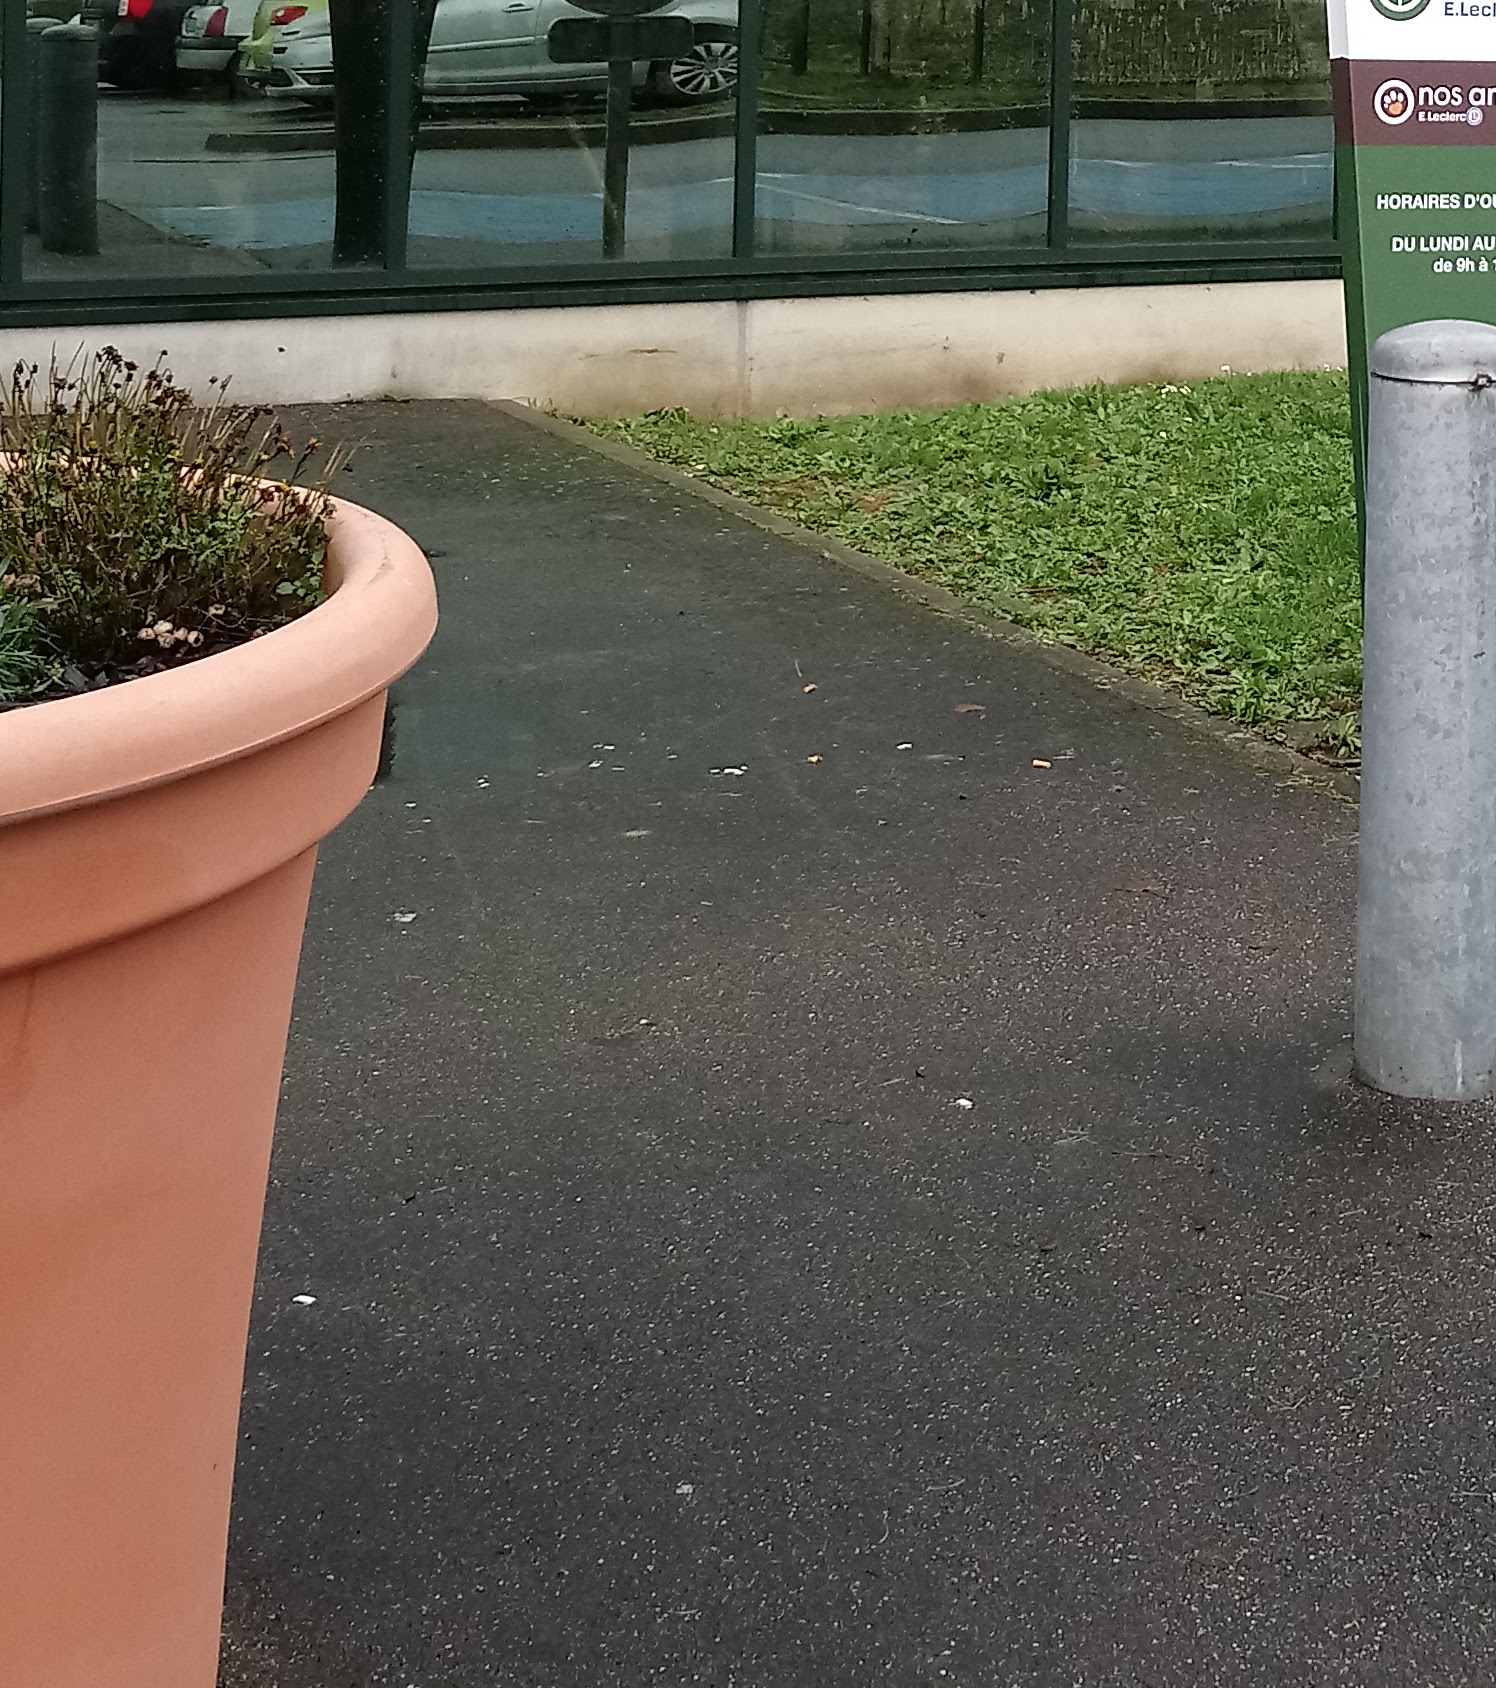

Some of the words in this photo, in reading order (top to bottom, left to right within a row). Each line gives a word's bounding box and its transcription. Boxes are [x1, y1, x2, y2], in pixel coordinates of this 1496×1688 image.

[1418, 86, 1463, 106] nos
[1418, 111, 1466, 122] ELeclerc
[1376, 193, 1461, 210] HORAIRES
[1391, 236, 1416, 252] DU
[1419, 236, 1469, 252] LUNDI
[1472, 235, 1496, 251] AU
[1433, 257, 1453, 273] de
[1456, 257, 1475, 272] 9h
[1478, 256, 1489, 272] à
